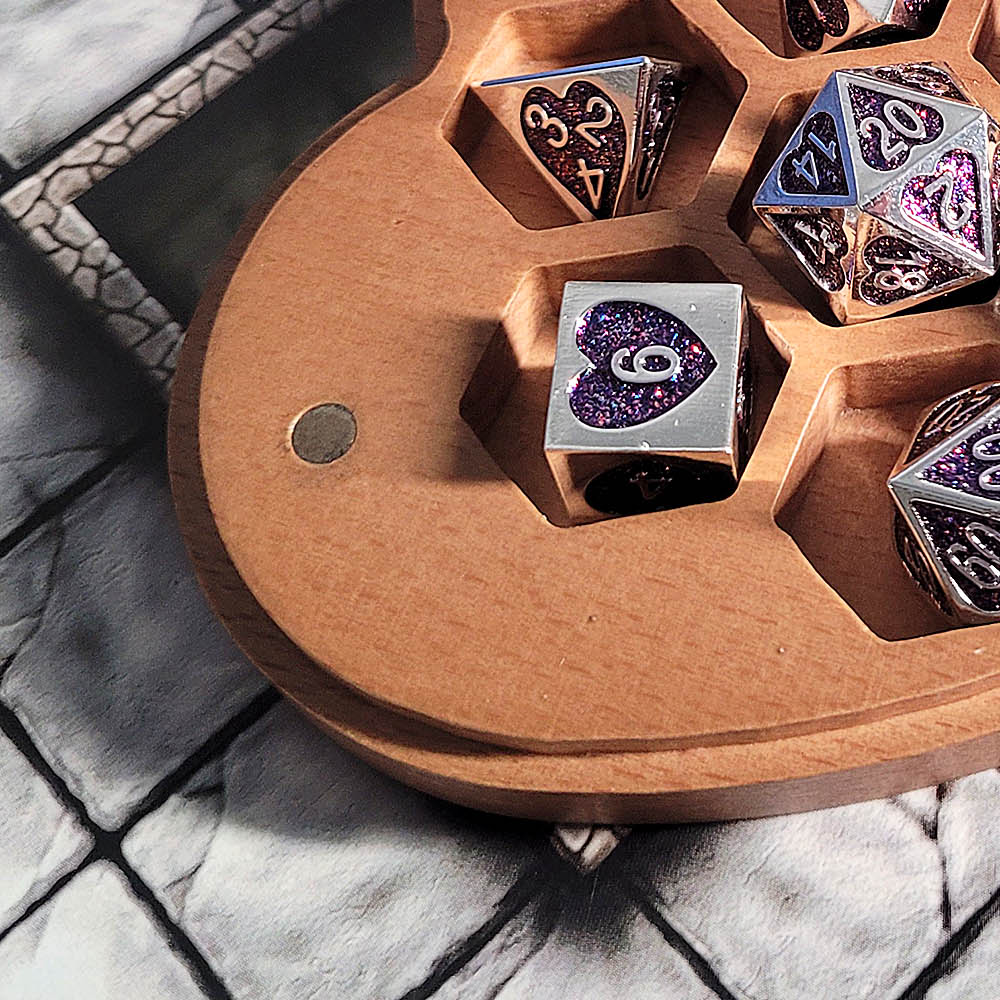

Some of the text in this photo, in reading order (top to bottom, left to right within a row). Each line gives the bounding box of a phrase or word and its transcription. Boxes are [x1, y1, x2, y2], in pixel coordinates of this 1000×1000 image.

[525, 104, 568, 148] 3
[574, 97, 612, 147] 2
[859, 99, 927, 163] 20
[577, 158, 604, 210] 4
[792, 132, 837, 191] 14
[924, 171, 977, 230] 2
[611, 345, 681, 384] 6
